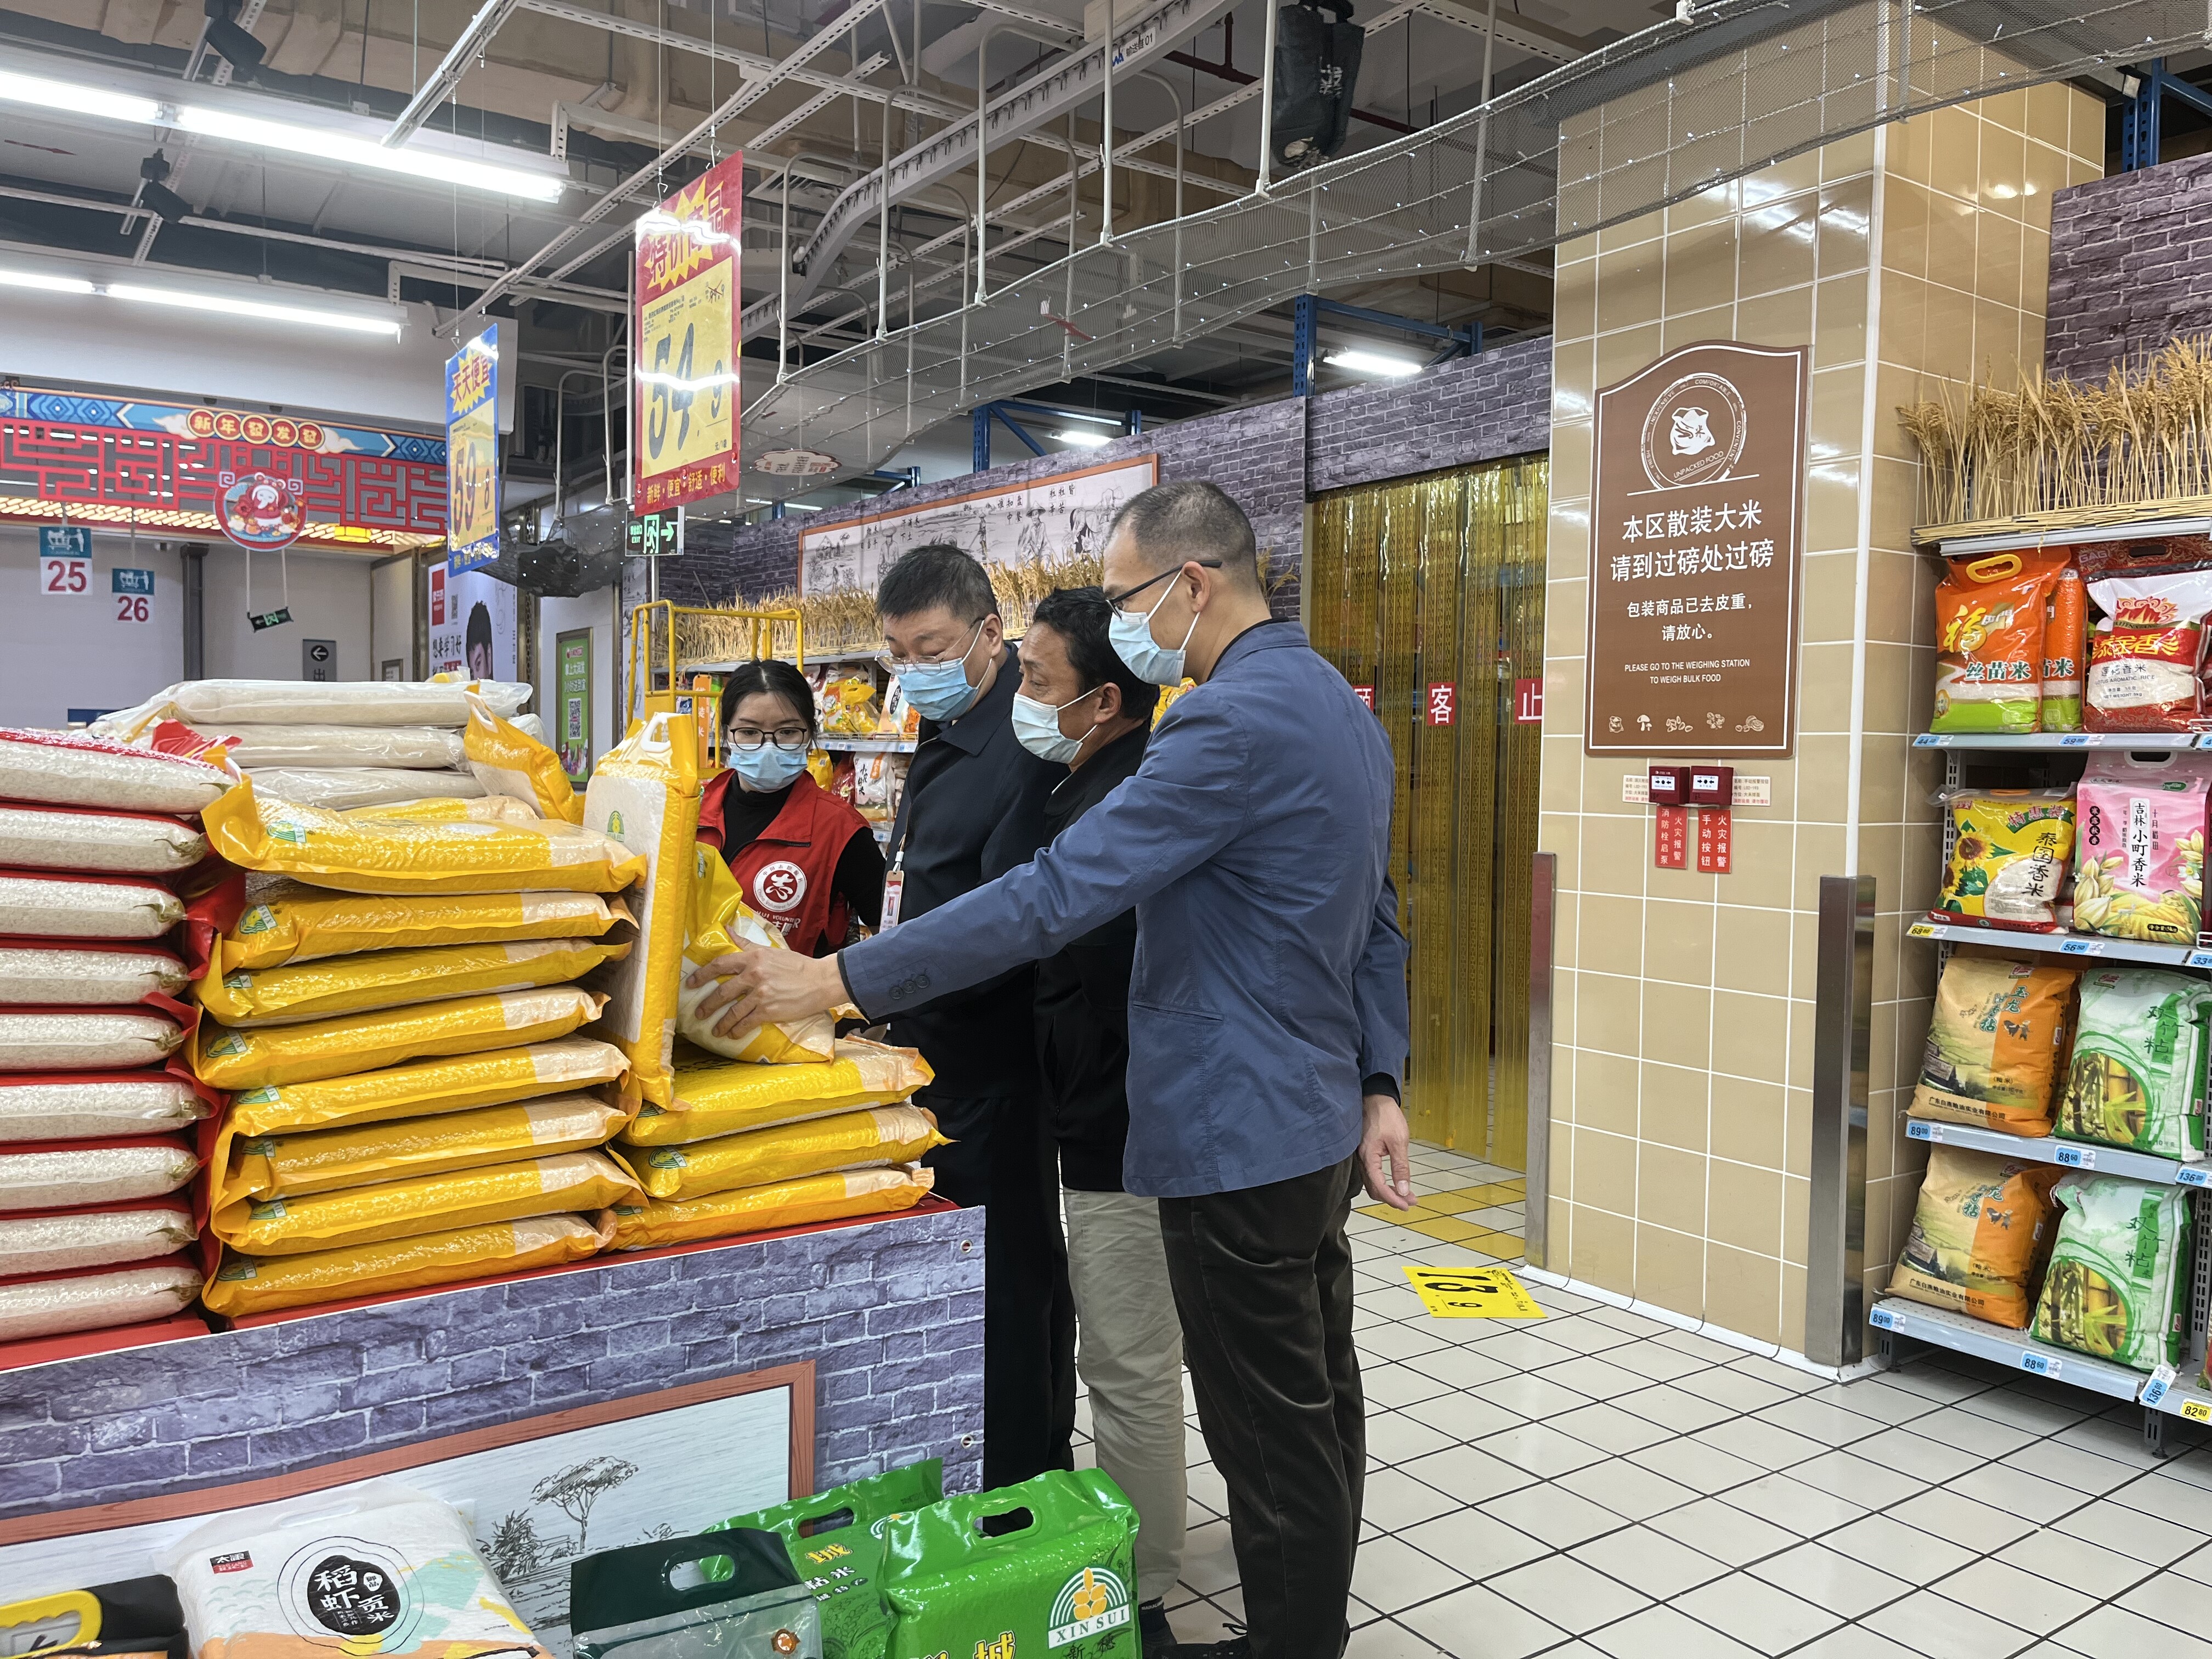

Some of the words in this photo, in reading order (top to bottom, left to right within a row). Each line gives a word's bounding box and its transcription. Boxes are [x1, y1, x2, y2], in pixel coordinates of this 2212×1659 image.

[1695, 379, 1731, 397] COMFORTABLE
[1650, 391, 1675, 425] INEXPENSIVE
[1728, 420, 1742, 461] CONVENIENT
[1673, 459, 1706, 478] UNPACKED
[1705, 450, 1724, 464] FOOD
[1622, 499, 1762, 543] 本区散装大米
[48, 560, 87, 592] 25
[1610, 538, 1774, 582] 请到过磅处过磅
[117, 595, 149, 622] 26
[1627, 592, 1752, 618] 包装商品已去皮重，
[1661, 623, 1712, 642] 请放心。
[1624, 663, 1649, 672] PLEASE
[1650, 663, 1660, 671] GO
[1661, 662, 1671, 670] TO
[1671, 661, 1684, 670] THE
[1686, 660, 1720, 669] WEIGHING
[1721, 659, 1750, 668] STATION
[1650, 676, 1659, 684] TO
[1660, 675, 1682, 684] WEIGH
[1683, 674, 1701, 683] BULK
[1702, 673, 1722, 682] FOOD
[1964, 660, 2032, 681] 丝苗米
[1430, 684, 1452, 724] 客
[1517, 682, 1543, 720] 止
[2007, 804, 2066, 827] 特惠装
[1660, 808, 1670, 865] 消防栓启泵
[1673, 816, 1683, 861] 火灾报警
[1701, 814, 1712, 867] 手动按钮
[1717, 815, 1728, 867] 火灾报警
[2130, 803, 2149, 887] 吉林小町香米
[2022, 832, 2058, 897] 泰国香米
[314, 1565, 360, 1612] 稻虾
[358, 1594, 395, 1624] 贡米
[1056, 1621, 1090, 1643] XIN
[1096, 1609, 1126, 1630] SUI
